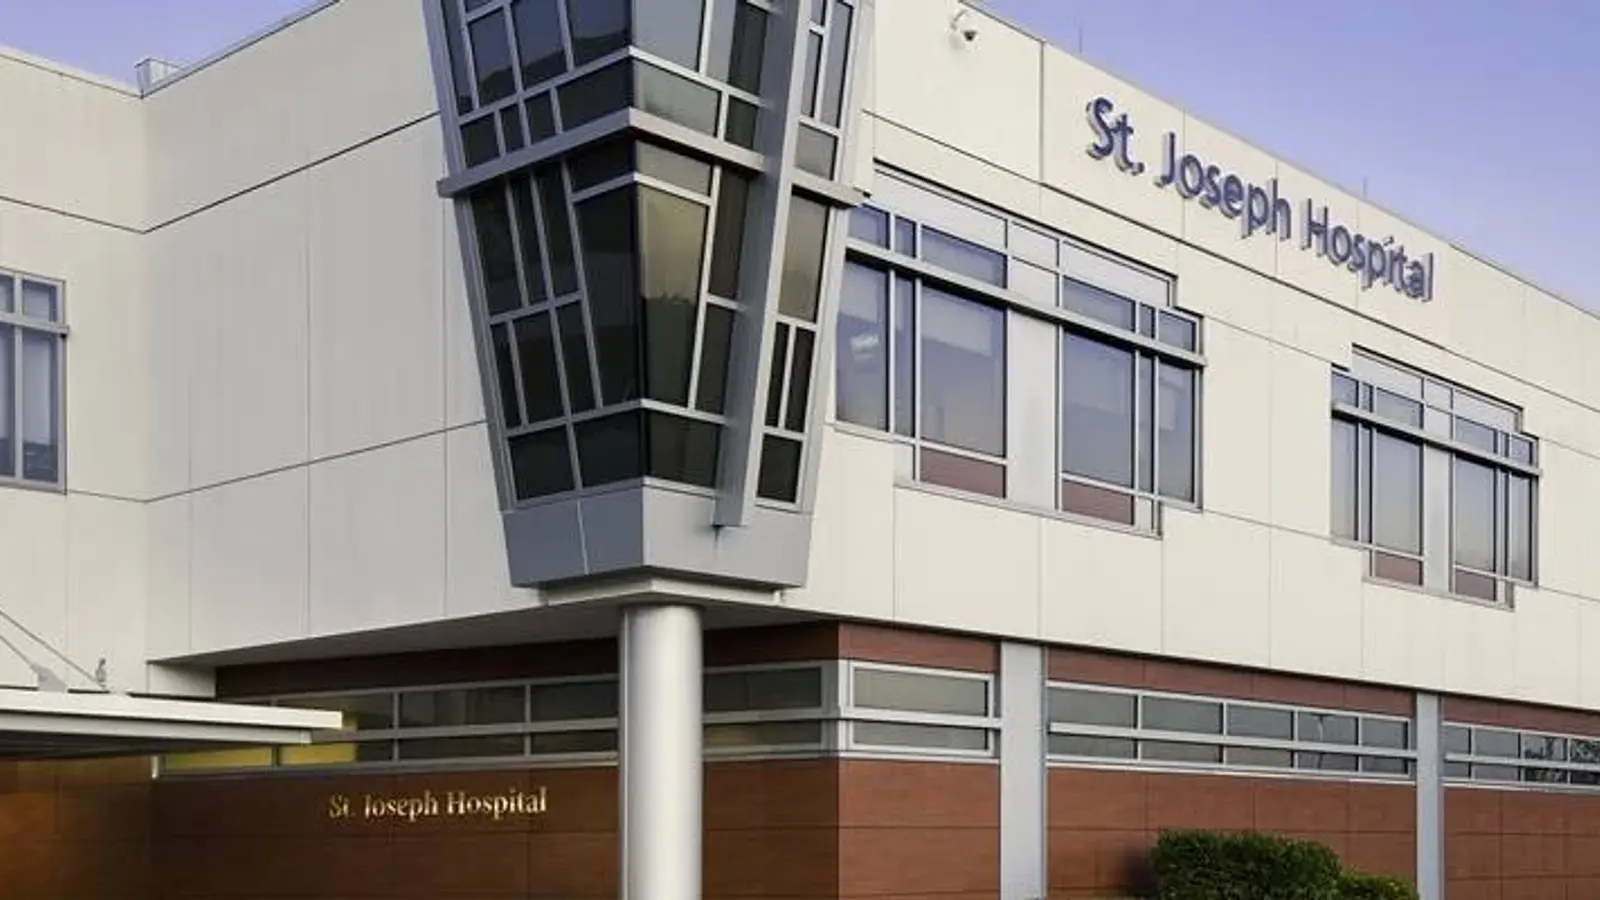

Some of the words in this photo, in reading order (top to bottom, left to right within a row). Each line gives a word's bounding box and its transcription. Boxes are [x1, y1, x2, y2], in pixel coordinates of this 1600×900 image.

[1086, 97, 1145, 176] St.
[1154, 132, 1292, 241] Joseph
[1300, 198, 1434, 303] Hospital
[364, 790, 439, 822] Joseph
[446, 786, 547, 820] Hospital
